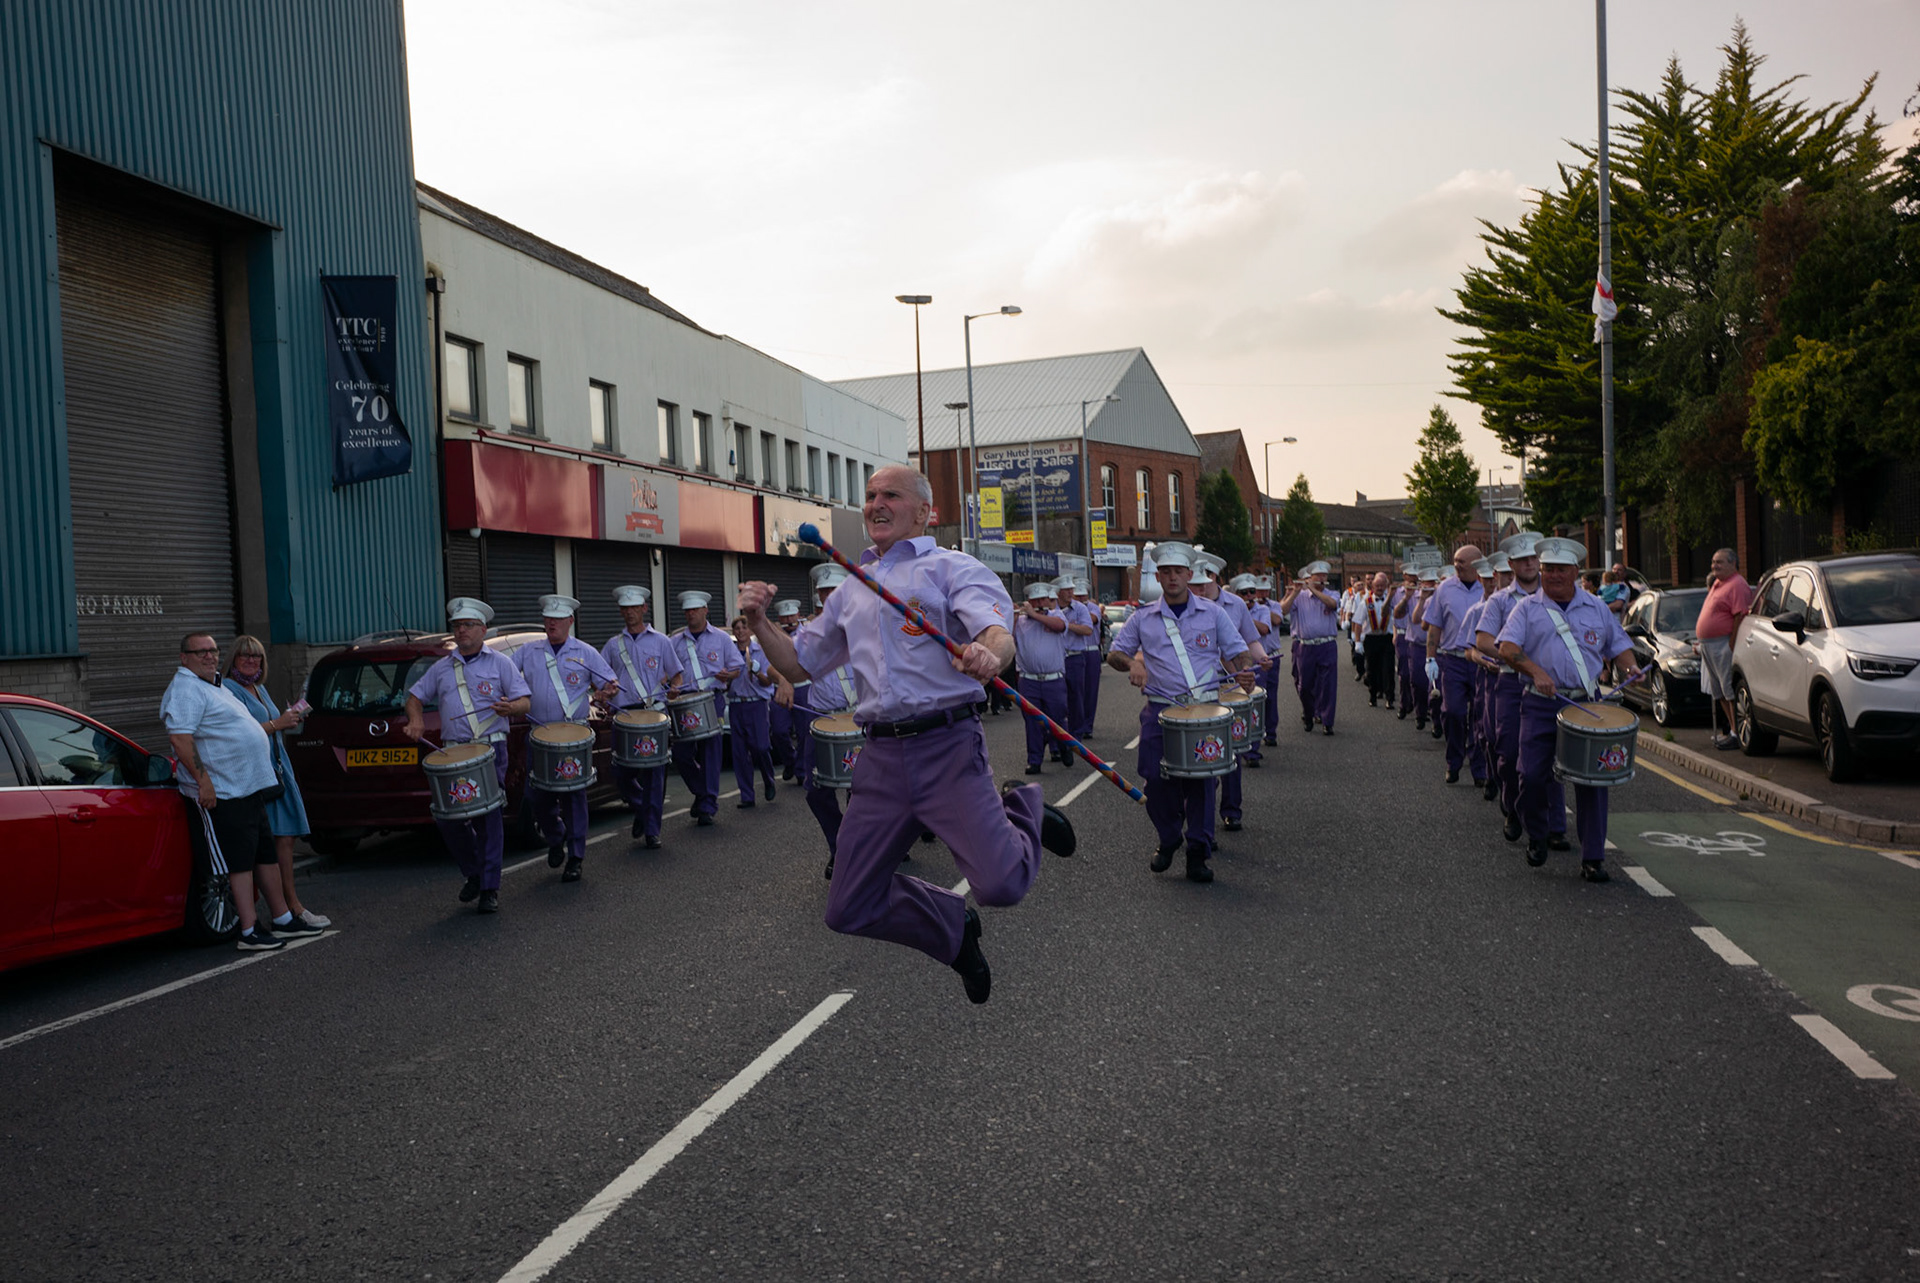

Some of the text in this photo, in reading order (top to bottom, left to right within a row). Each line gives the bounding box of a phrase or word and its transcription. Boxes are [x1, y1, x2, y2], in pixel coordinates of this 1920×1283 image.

[336, 317, 377, 337] TTC
[335, 379, 390, 393] Celebrang
[351, 394, 389, 423] 70
[348, 424, 394, 439] years of
[342, 437, 401, 449] excellence
[983, 446, 1055, 460] Gary Hutchnson
[983, 455, 1074, 470] Used Car Sales
[76, 594, 164, 615] NO PARKING
[354, 750, 410, 764] UKZ 9152
